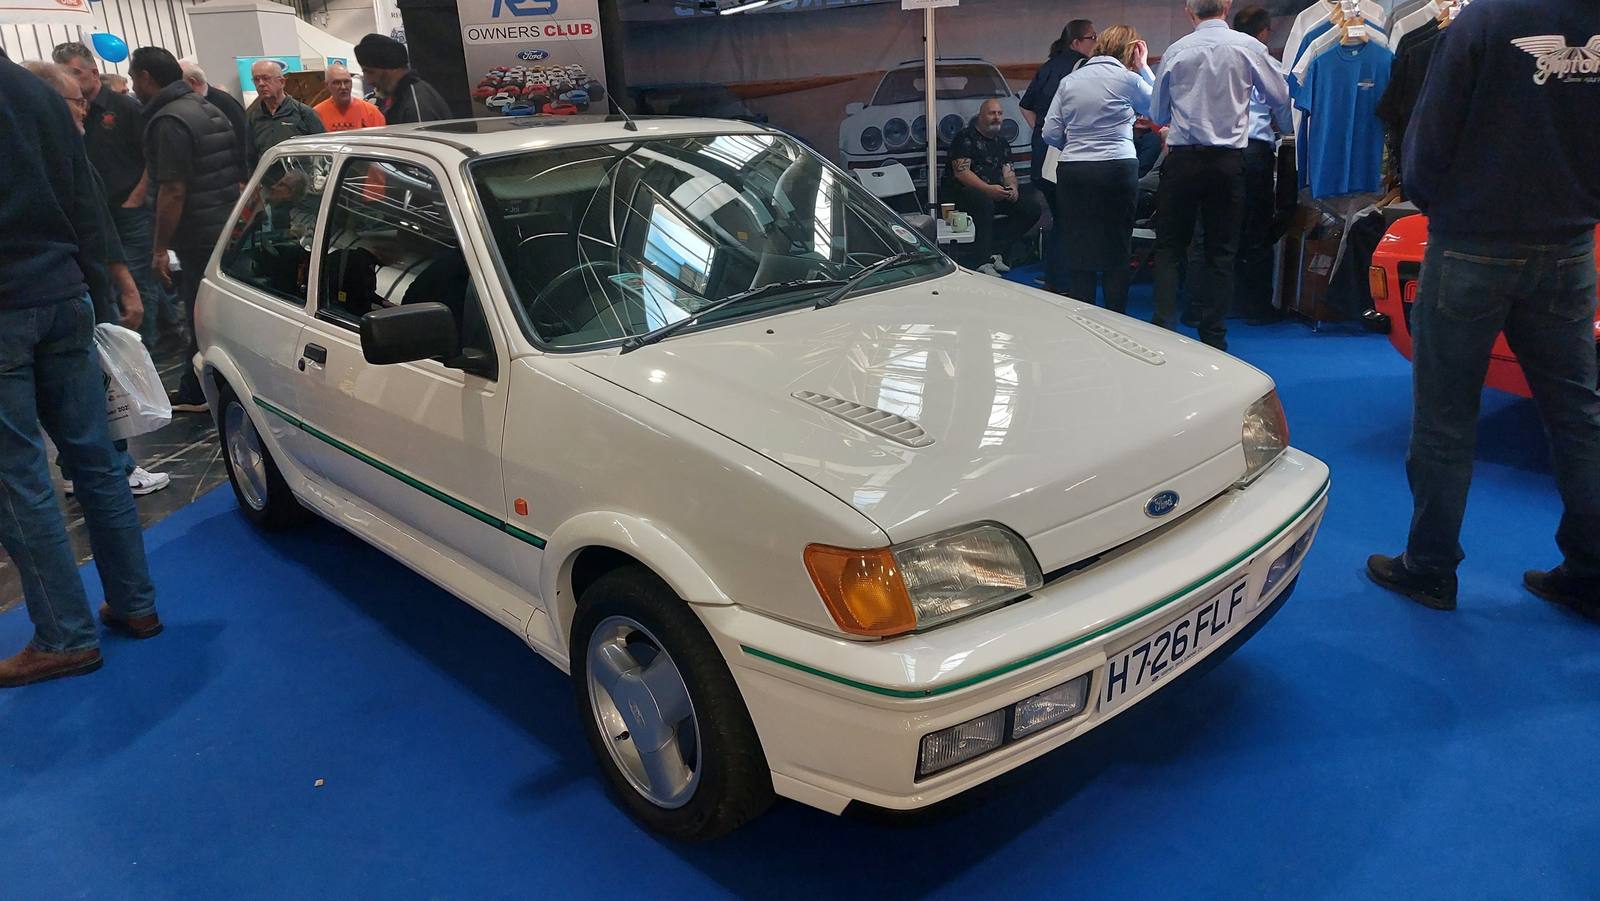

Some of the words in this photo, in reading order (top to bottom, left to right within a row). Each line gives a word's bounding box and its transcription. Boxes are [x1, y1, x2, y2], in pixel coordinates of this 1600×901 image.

[468, 25, 540, 41] OWNERS
[543, 23, 594, 37] CLUB
[522, 50, 543, 60] Ford
[1154, 494, 1173, 512] Ford
[1106, 619, 1191, 703] H726
[1192, 580, 1247, 649] FLF
